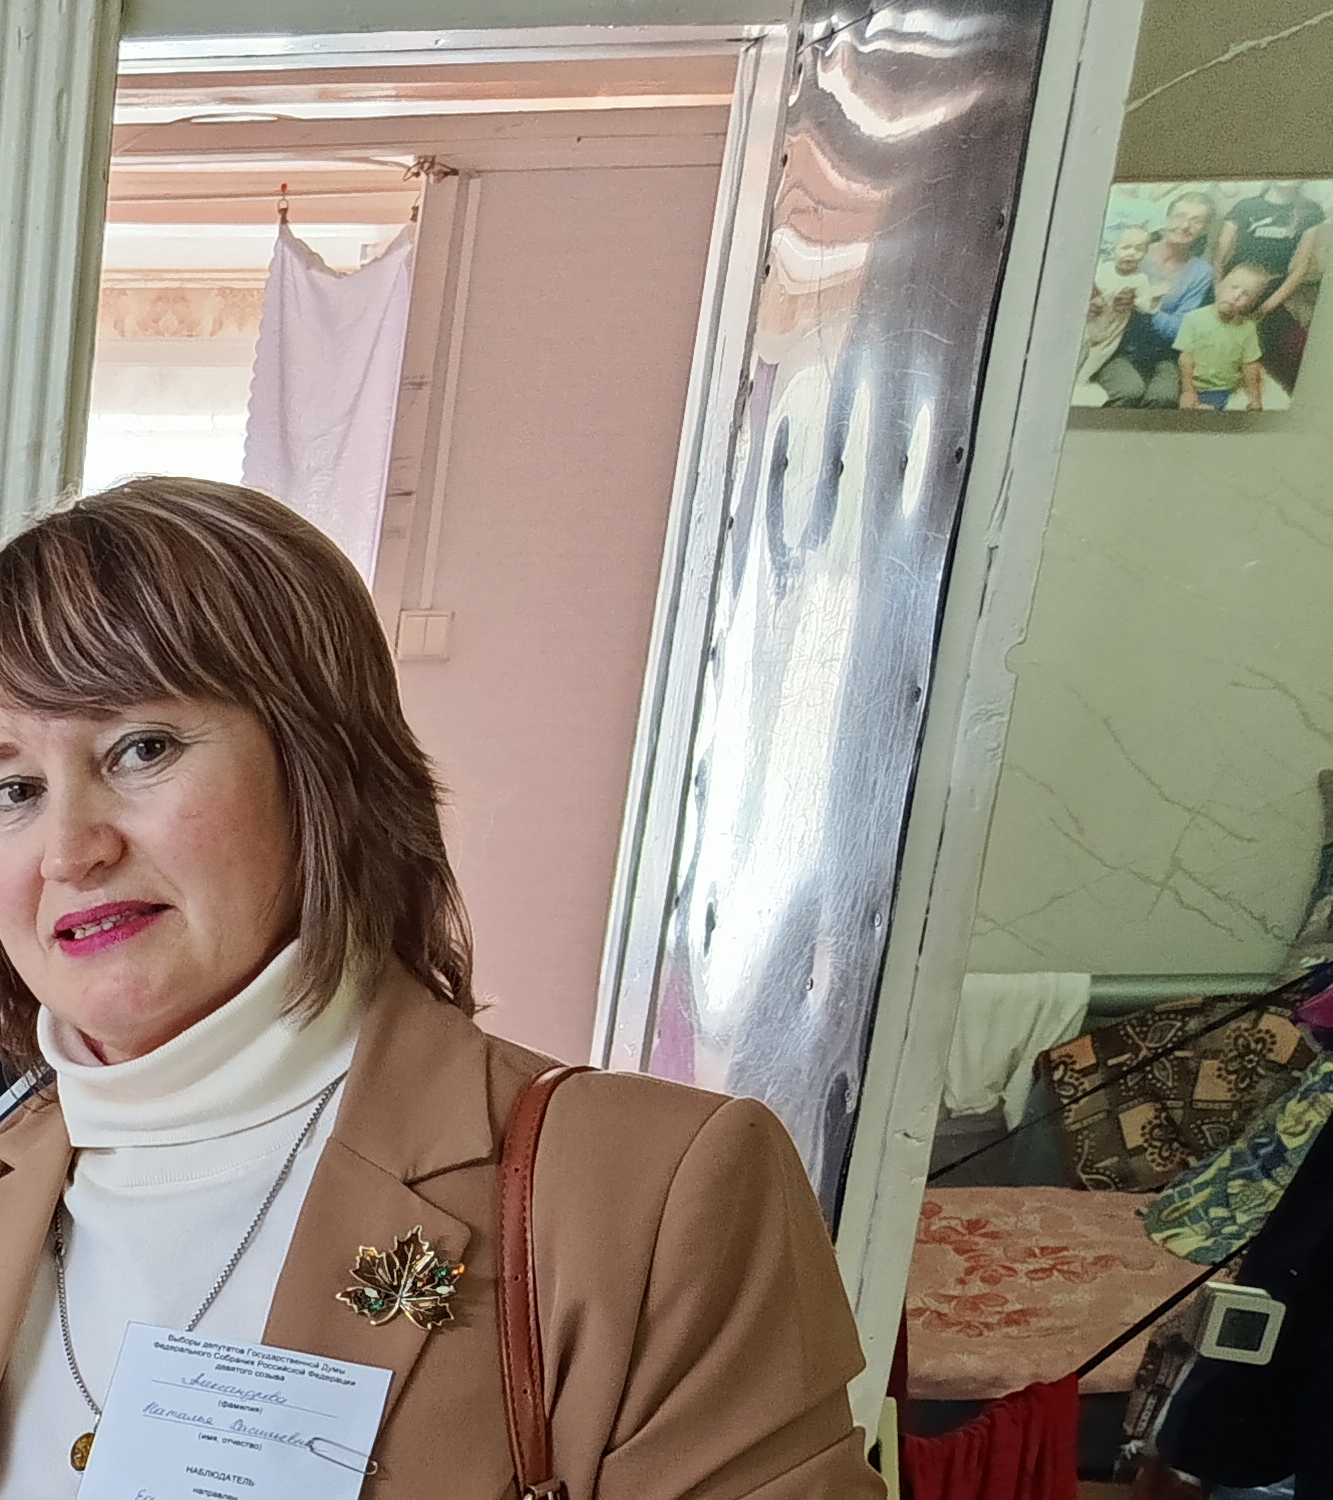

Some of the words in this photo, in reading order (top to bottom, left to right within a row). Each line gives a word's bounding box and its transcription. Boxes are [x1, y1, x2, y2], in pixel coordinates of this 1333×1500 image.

[153, 1341, 212, 1359] Федерального
[213, 1352, 255, 1366] Собрания
[257, 1360, 306, 1375] Российской
[308, 1370, 356, 1386] Федерации
[167, 1333, 201, 1347] Выборы
[202, 1341, 245, 1355] депутатов
[246, 1348, 320, 1369] Государственной
[321, 1363, 346, 1375] Думы
[214, 1364, 253, 1376] девятого
[254, 1371, 285, 1382] созыва
[217, 1399, 264, 1415] (фамилия)
[198, 1431, 220, 1444] (имя,
[221, 1436, 263, 1452] отчество)
[185, 1465, 255, 1487] НАБЛЮДАТЕЛЬ
